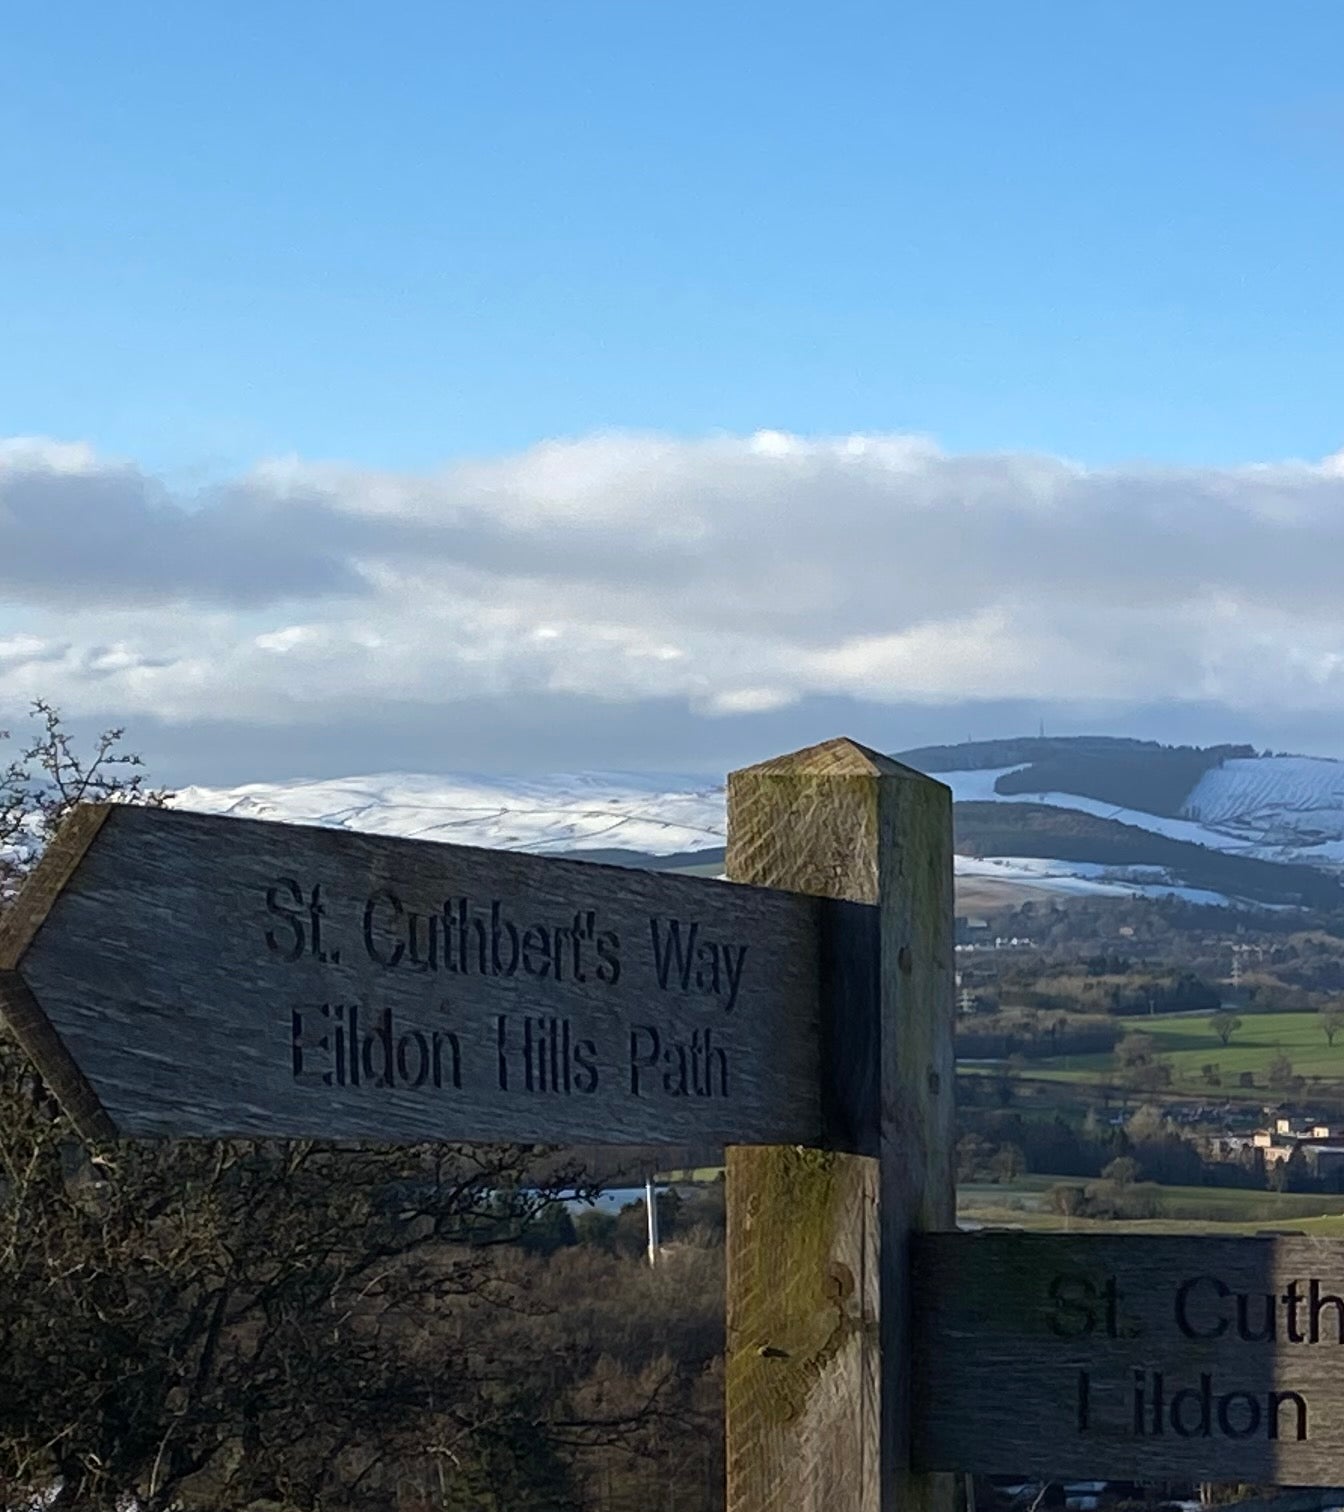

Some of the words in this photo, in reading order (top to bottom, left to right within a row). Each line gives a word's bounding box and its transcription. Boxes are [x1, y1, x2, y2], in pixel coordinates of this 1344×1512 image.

[266, 877, 340, 963] St.
[363, 887, 621, 985] Cuthbert's
[650, 917, 750, 1014] Way
[292, 1002, 462, 1090] Eildon
[498, 1014, 599, 1096] Hills
[630, 1023, 729, 1099] Path
